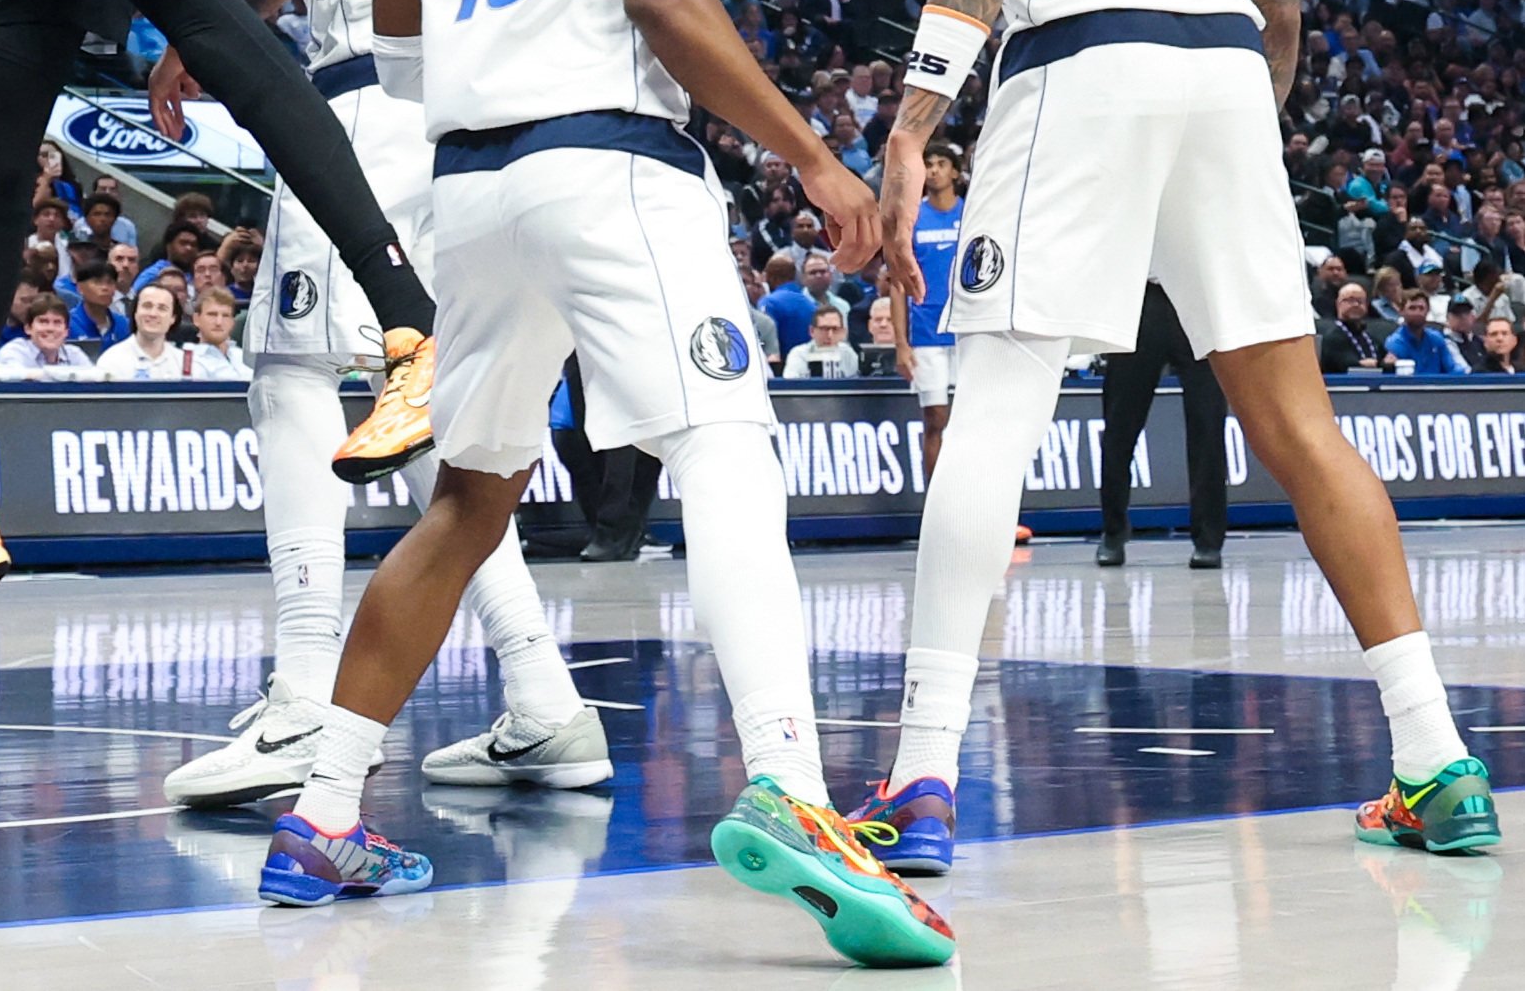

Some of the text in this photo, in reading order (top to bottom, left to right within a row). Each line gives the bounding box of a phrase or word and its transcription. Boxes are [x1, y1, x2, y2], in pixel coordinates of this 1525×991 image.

[52, 429, 263, 513] REWARDS
[776, 421, 904, 497] WARDS
[1026, 419, 1081, 490] ERY
[1418, 414, 1477, 482] FOR
